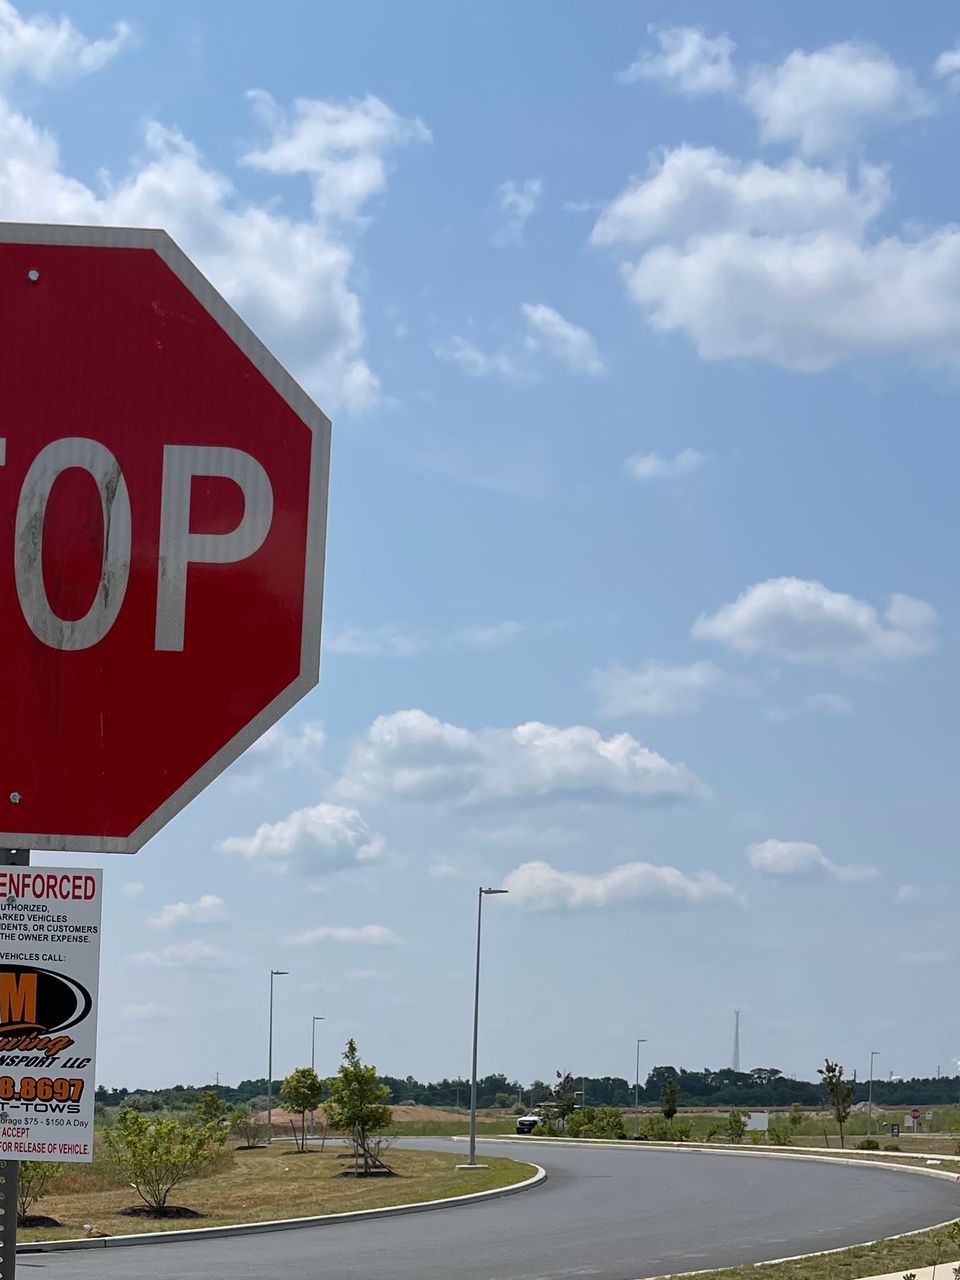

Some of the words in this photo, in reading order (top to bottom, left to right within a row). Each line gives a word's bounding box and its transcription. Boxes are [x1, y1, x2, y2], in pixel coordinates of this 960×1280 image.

[27, 914, 67, 922] VEHICLES
[33, 924, 45, 932] OR
[47, 925, 98, 934] CUSTOMERS
[18, 933, 48, 942] OWNER
[0, 952, 39, 961] VEHICLES
[42, 953, 66, 962] CALL:
[60, 1057, 91, 1069] LLC
[24, 1117, 38, 1126] $75
[46, 1118, 64, 1126] $150
[74, 1119, 89, 1128] Day
[2, 1127, 30, 1138] ACCEPT
[0, 1142, 13, 1152] FOR
[15, 1143, 45, 1153] RELEASE
[47, 1144, 57, 1154] OF
